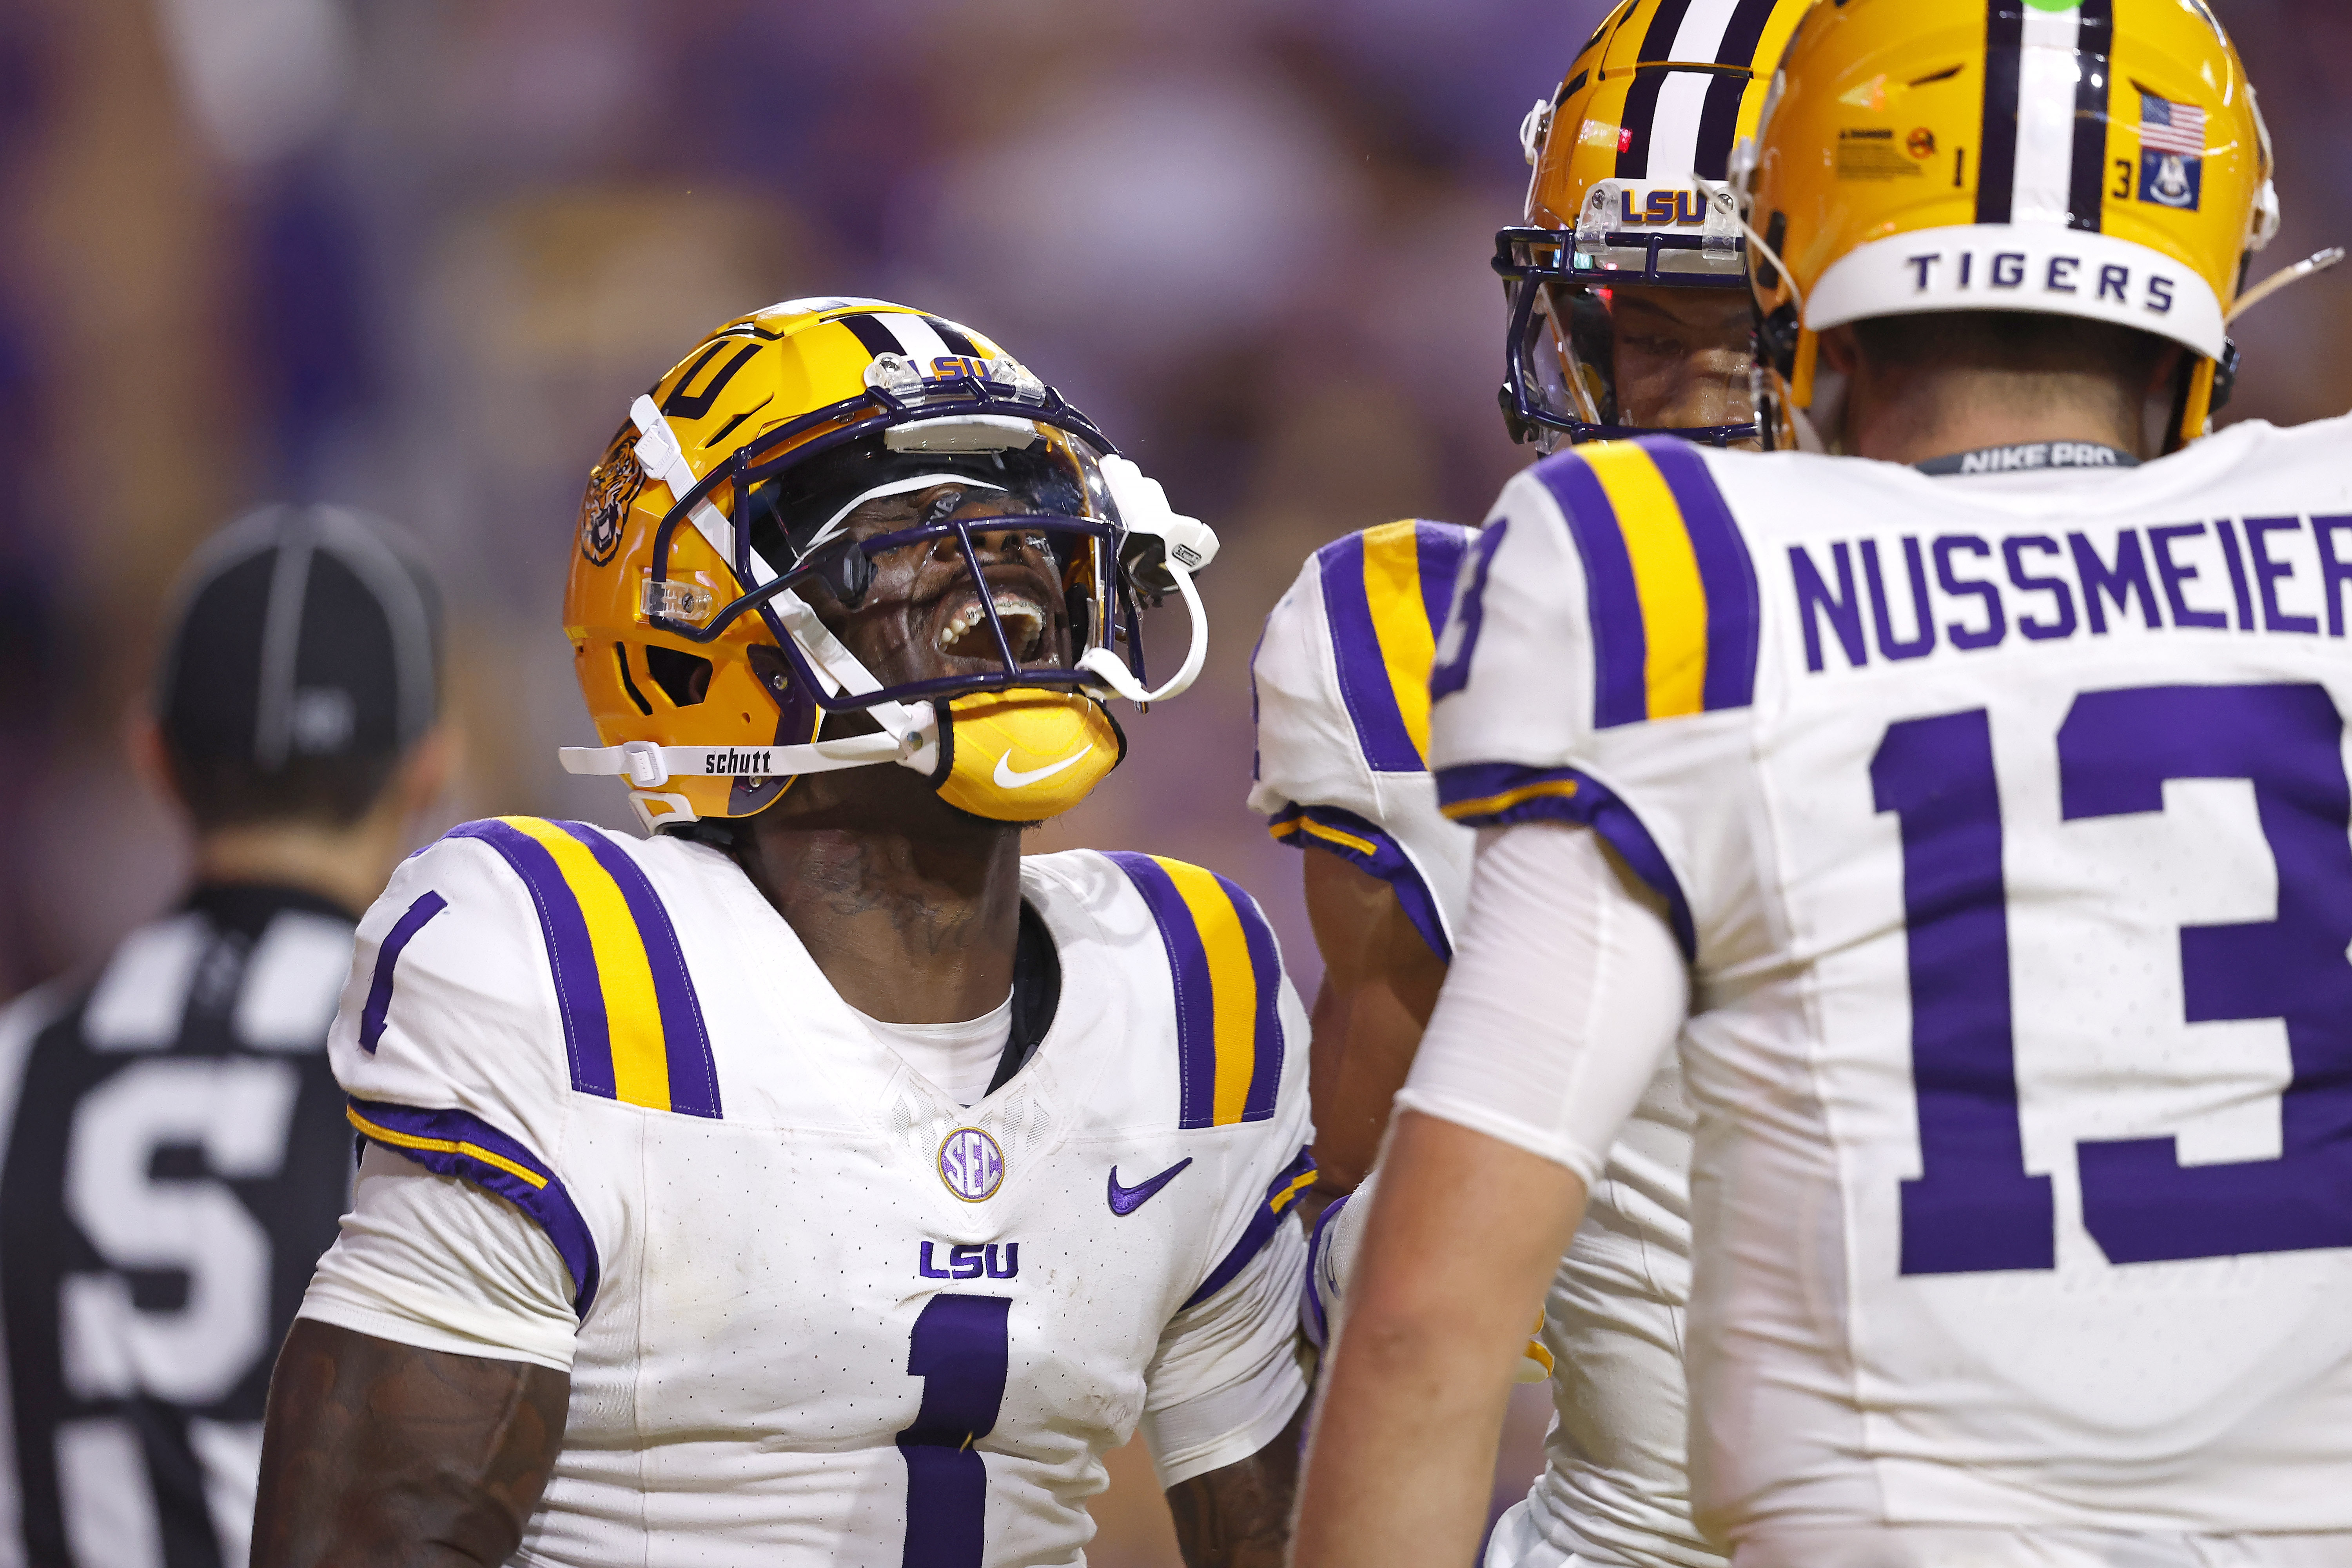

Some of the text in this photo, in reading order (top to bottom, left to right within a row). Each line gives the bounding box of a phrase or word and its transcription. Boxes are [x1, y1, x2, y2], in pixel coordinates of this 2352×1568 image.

[1622, 189, 1707, 225] LSU
[2113, 160, 2131, 199] 3
[1908, 252, 2174, 313] TIGERS
[1961, 444, 2047, 474] NIKE
[706, 748, 771, 773] schutt
[359, 889, 448, 1054] 1
[1869, 682, 2352, 1276] 13
[945, 1132, 1001, 1196] SEC
[59, 1056, 301, 1404] S
[920, 1241, 1019, 1279] LSU
[895, 1293, 1013, 1568] 1
